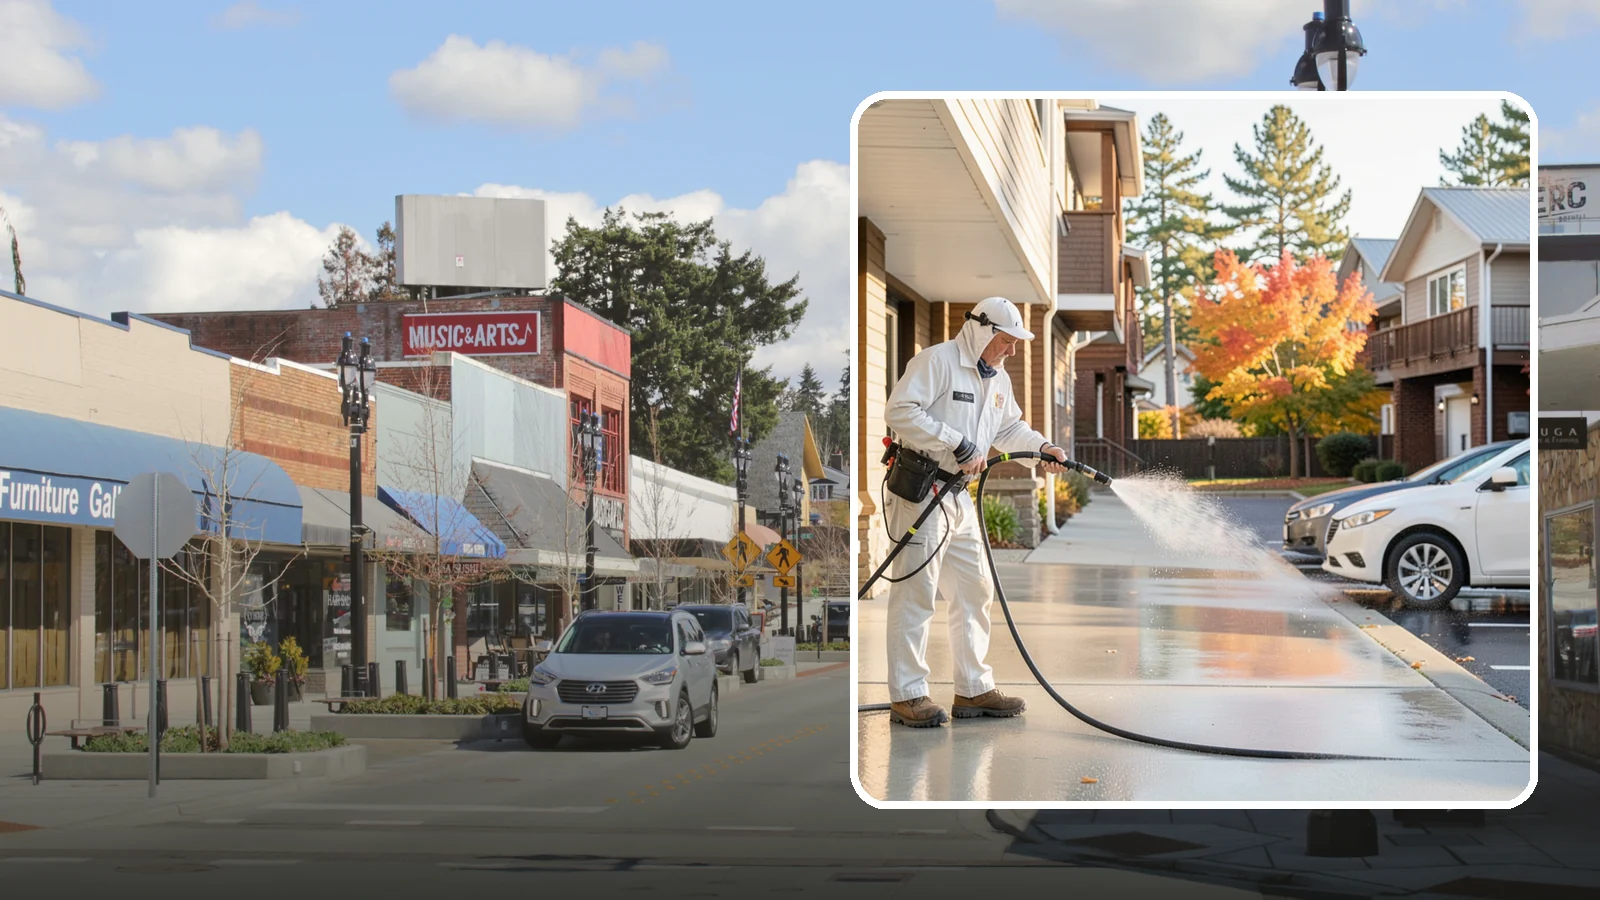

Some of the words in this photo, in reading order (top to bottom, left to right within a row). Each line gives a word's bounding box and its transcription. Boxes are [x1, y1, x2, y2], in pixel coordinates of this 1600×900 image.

[409, 323, 519, 348] MUSIC&ARTS
[1540, 427, 1577, 436] UGA
[0, 472, 79, 515] Furniture
[89, 482, 121, 518] Gal
[453, 563, 479, 574] SUSHI
